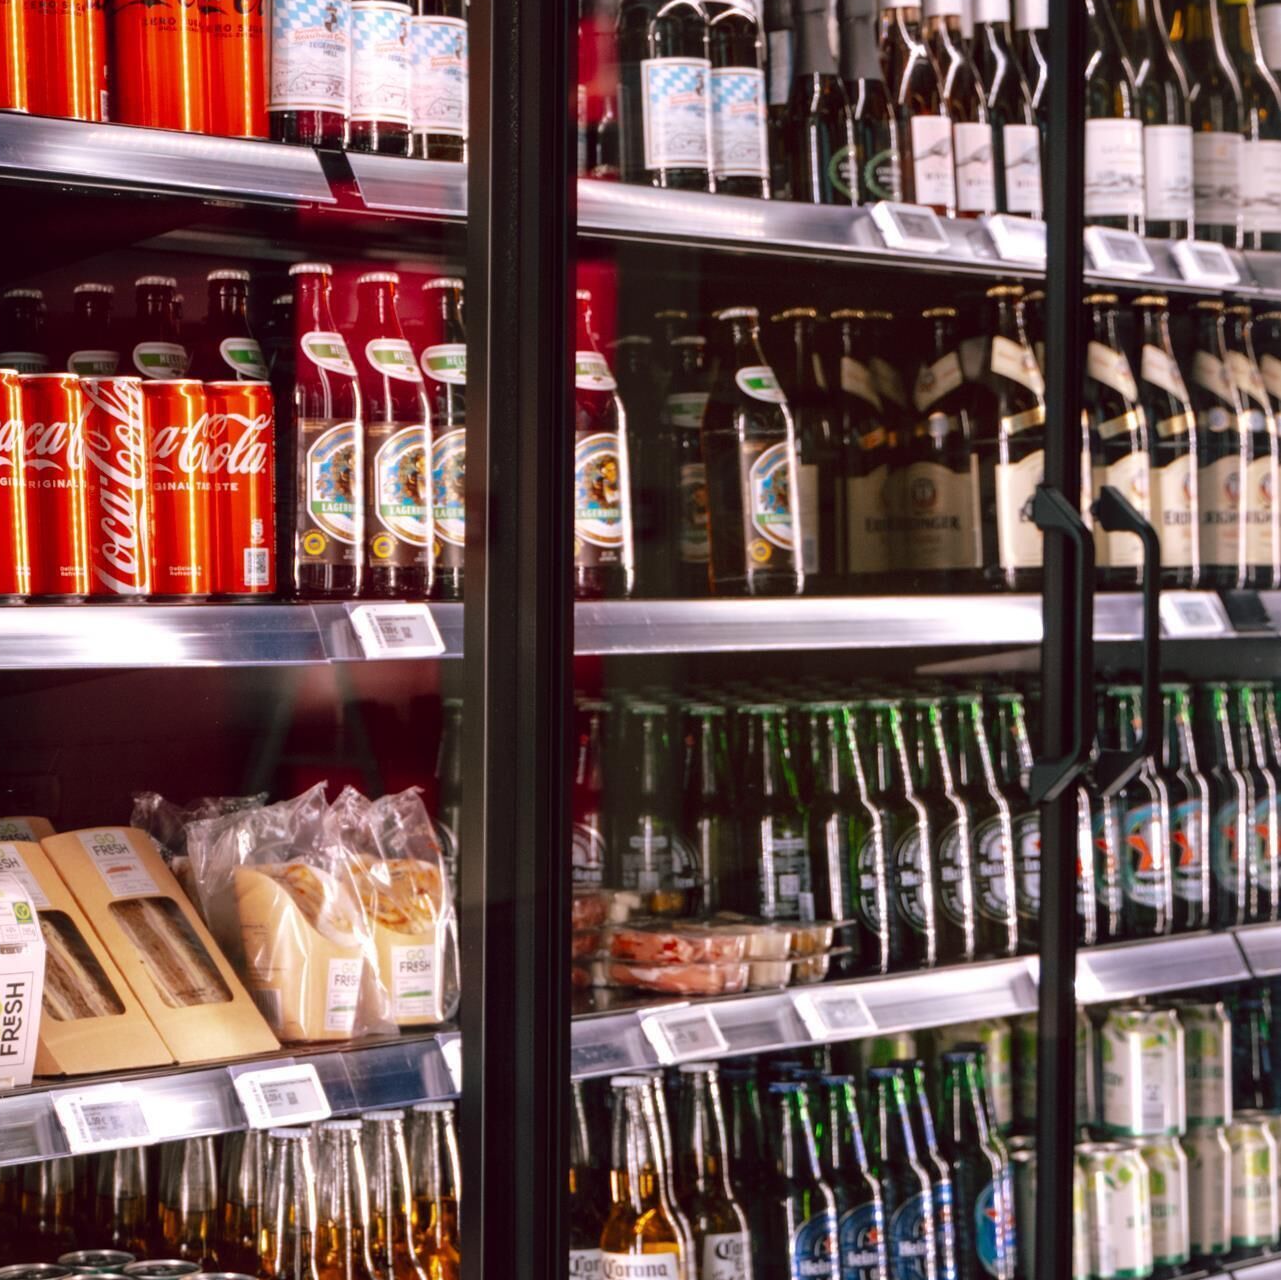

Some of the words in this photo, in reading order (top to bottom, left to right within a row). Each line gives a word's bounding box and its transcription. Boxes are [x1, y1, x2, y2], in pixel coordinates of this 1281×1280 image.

[93, 832, 117, 845] GO
[92, 843, 130, 857] FRESH
[406, 949, 426, 961] GO
[399, 960, 431, 973] FRESH
[0, 981, 25, 1057] FRESH
[602, 1258, 668, 1279] Corona
